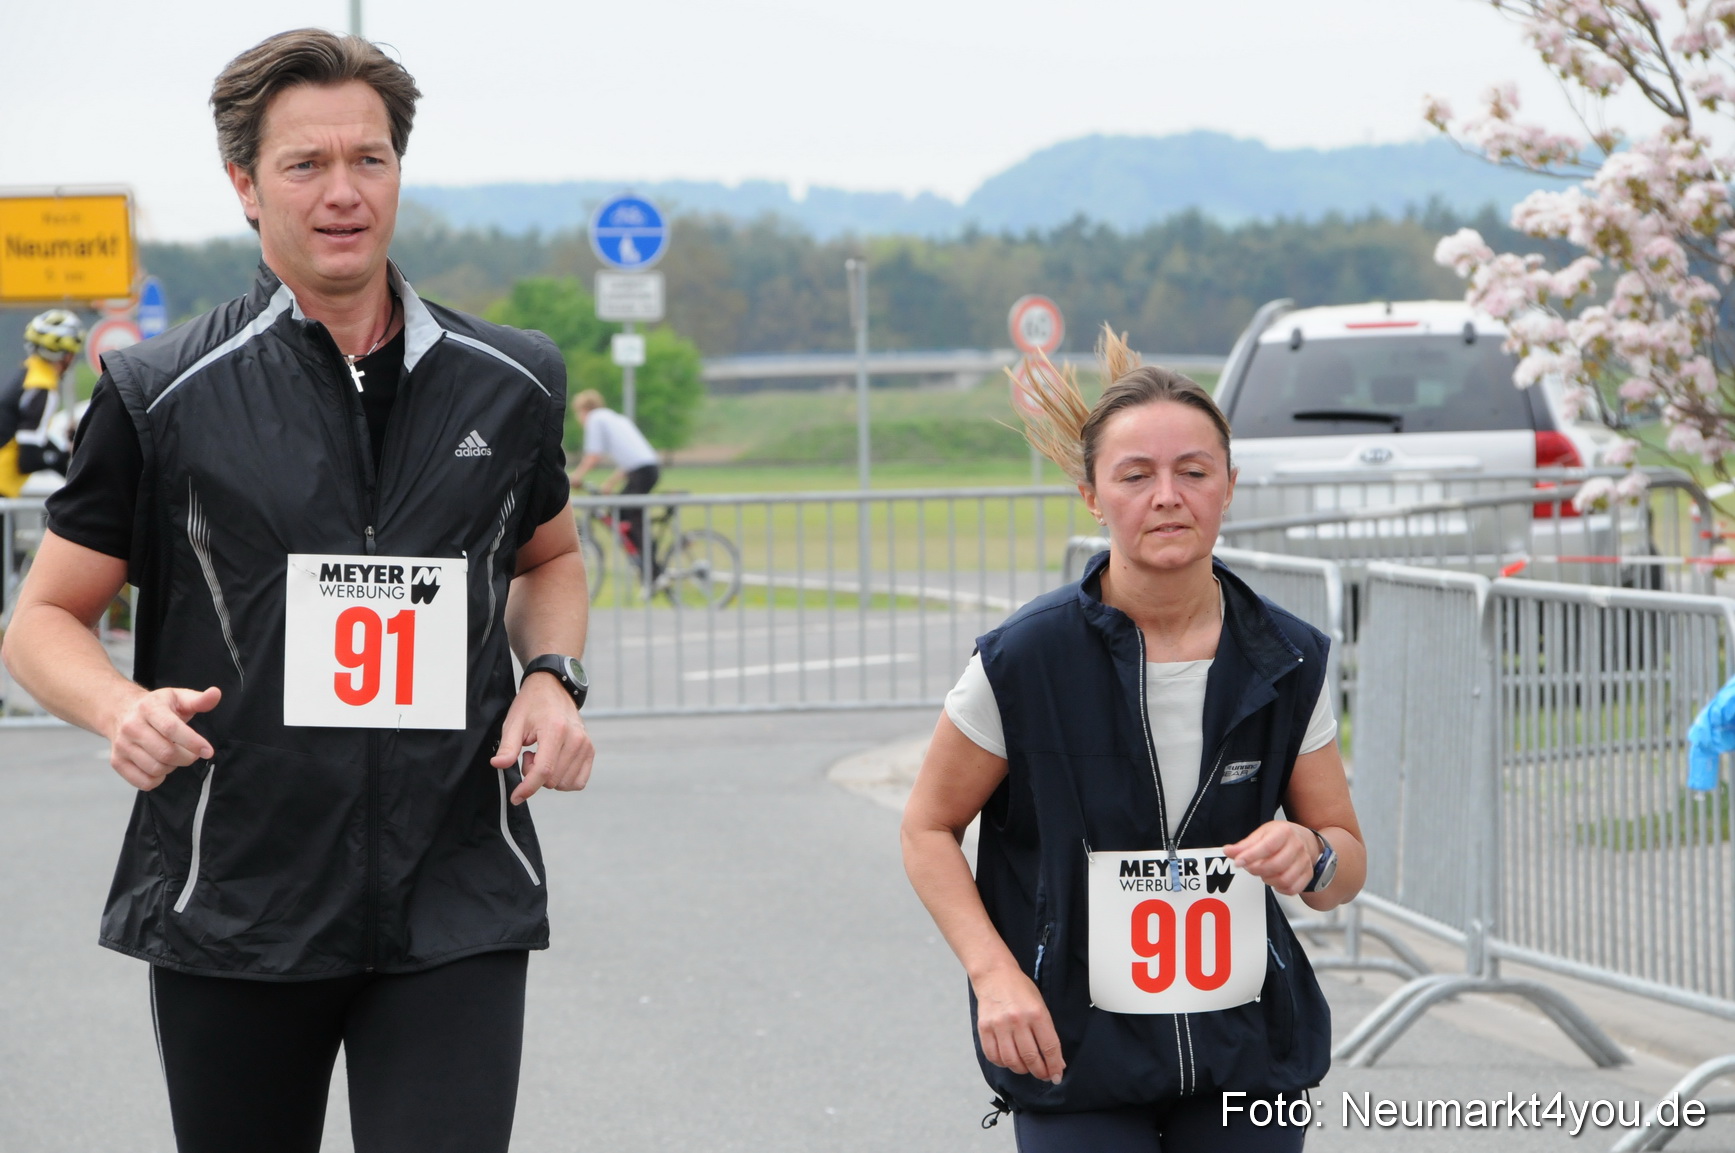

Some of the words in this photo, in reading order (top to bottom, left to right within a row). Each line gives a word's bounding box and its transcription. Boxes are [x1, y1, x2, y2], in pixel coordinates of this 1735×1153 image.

[5, 233, 118, 258] Neumarkt
[454, 446, 492, 457] adidas
[319, 563, 405, 584] MEYER
[319, 583, 405, 600] WERBUNG
[334, 606, 416, 706] 91
[1131, 897, 1232, 994] 90
